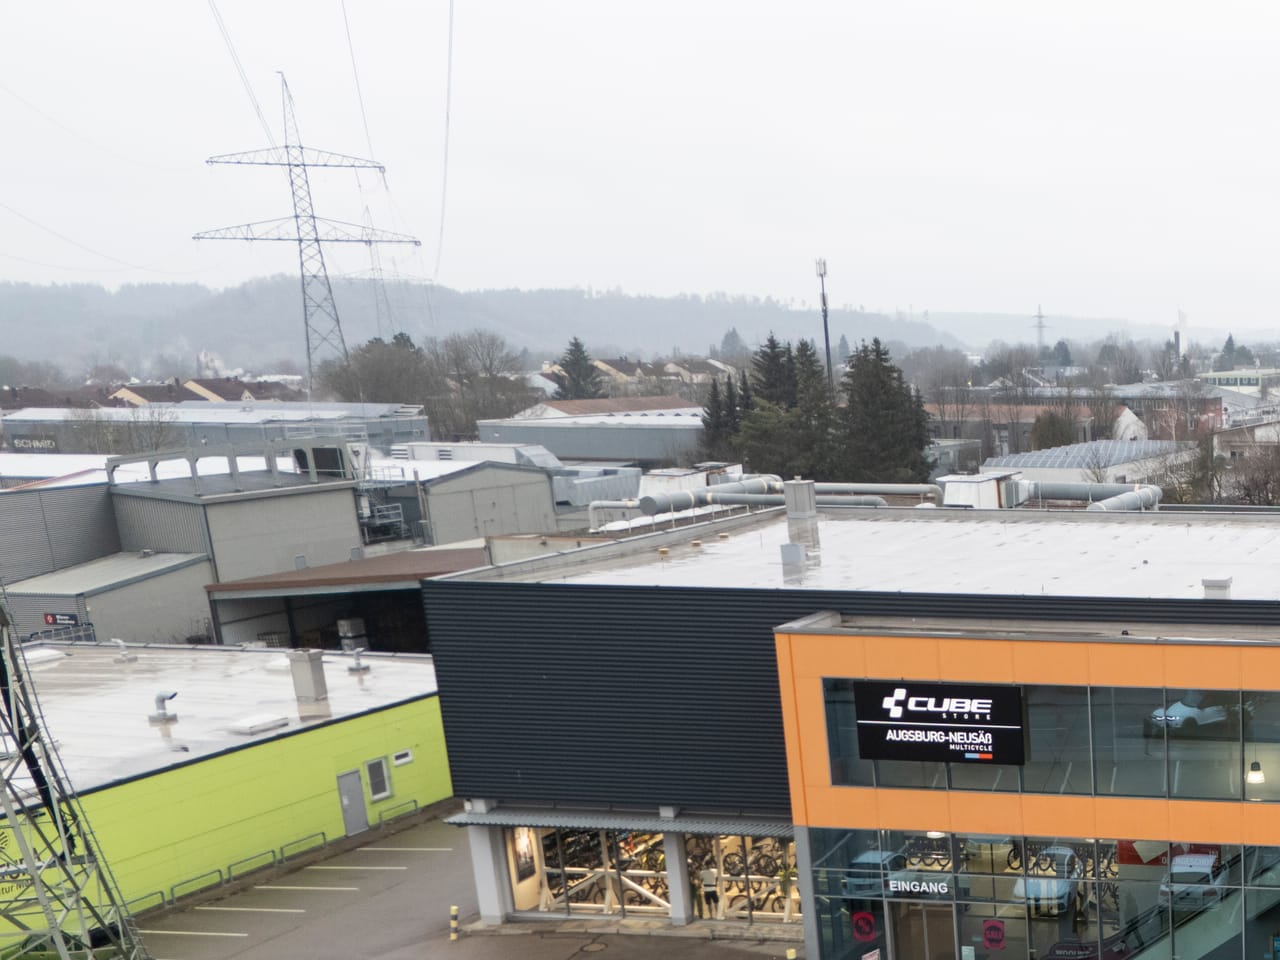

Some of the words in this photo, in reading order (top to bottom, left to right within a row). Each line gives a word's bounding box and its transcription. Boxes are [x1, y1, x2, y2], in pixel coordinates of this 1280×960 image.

[14, 439, 56, 448] SCHMID
[907, 697, 993, 713] CUBE
[888, 880, 949, 893] EINGANG
